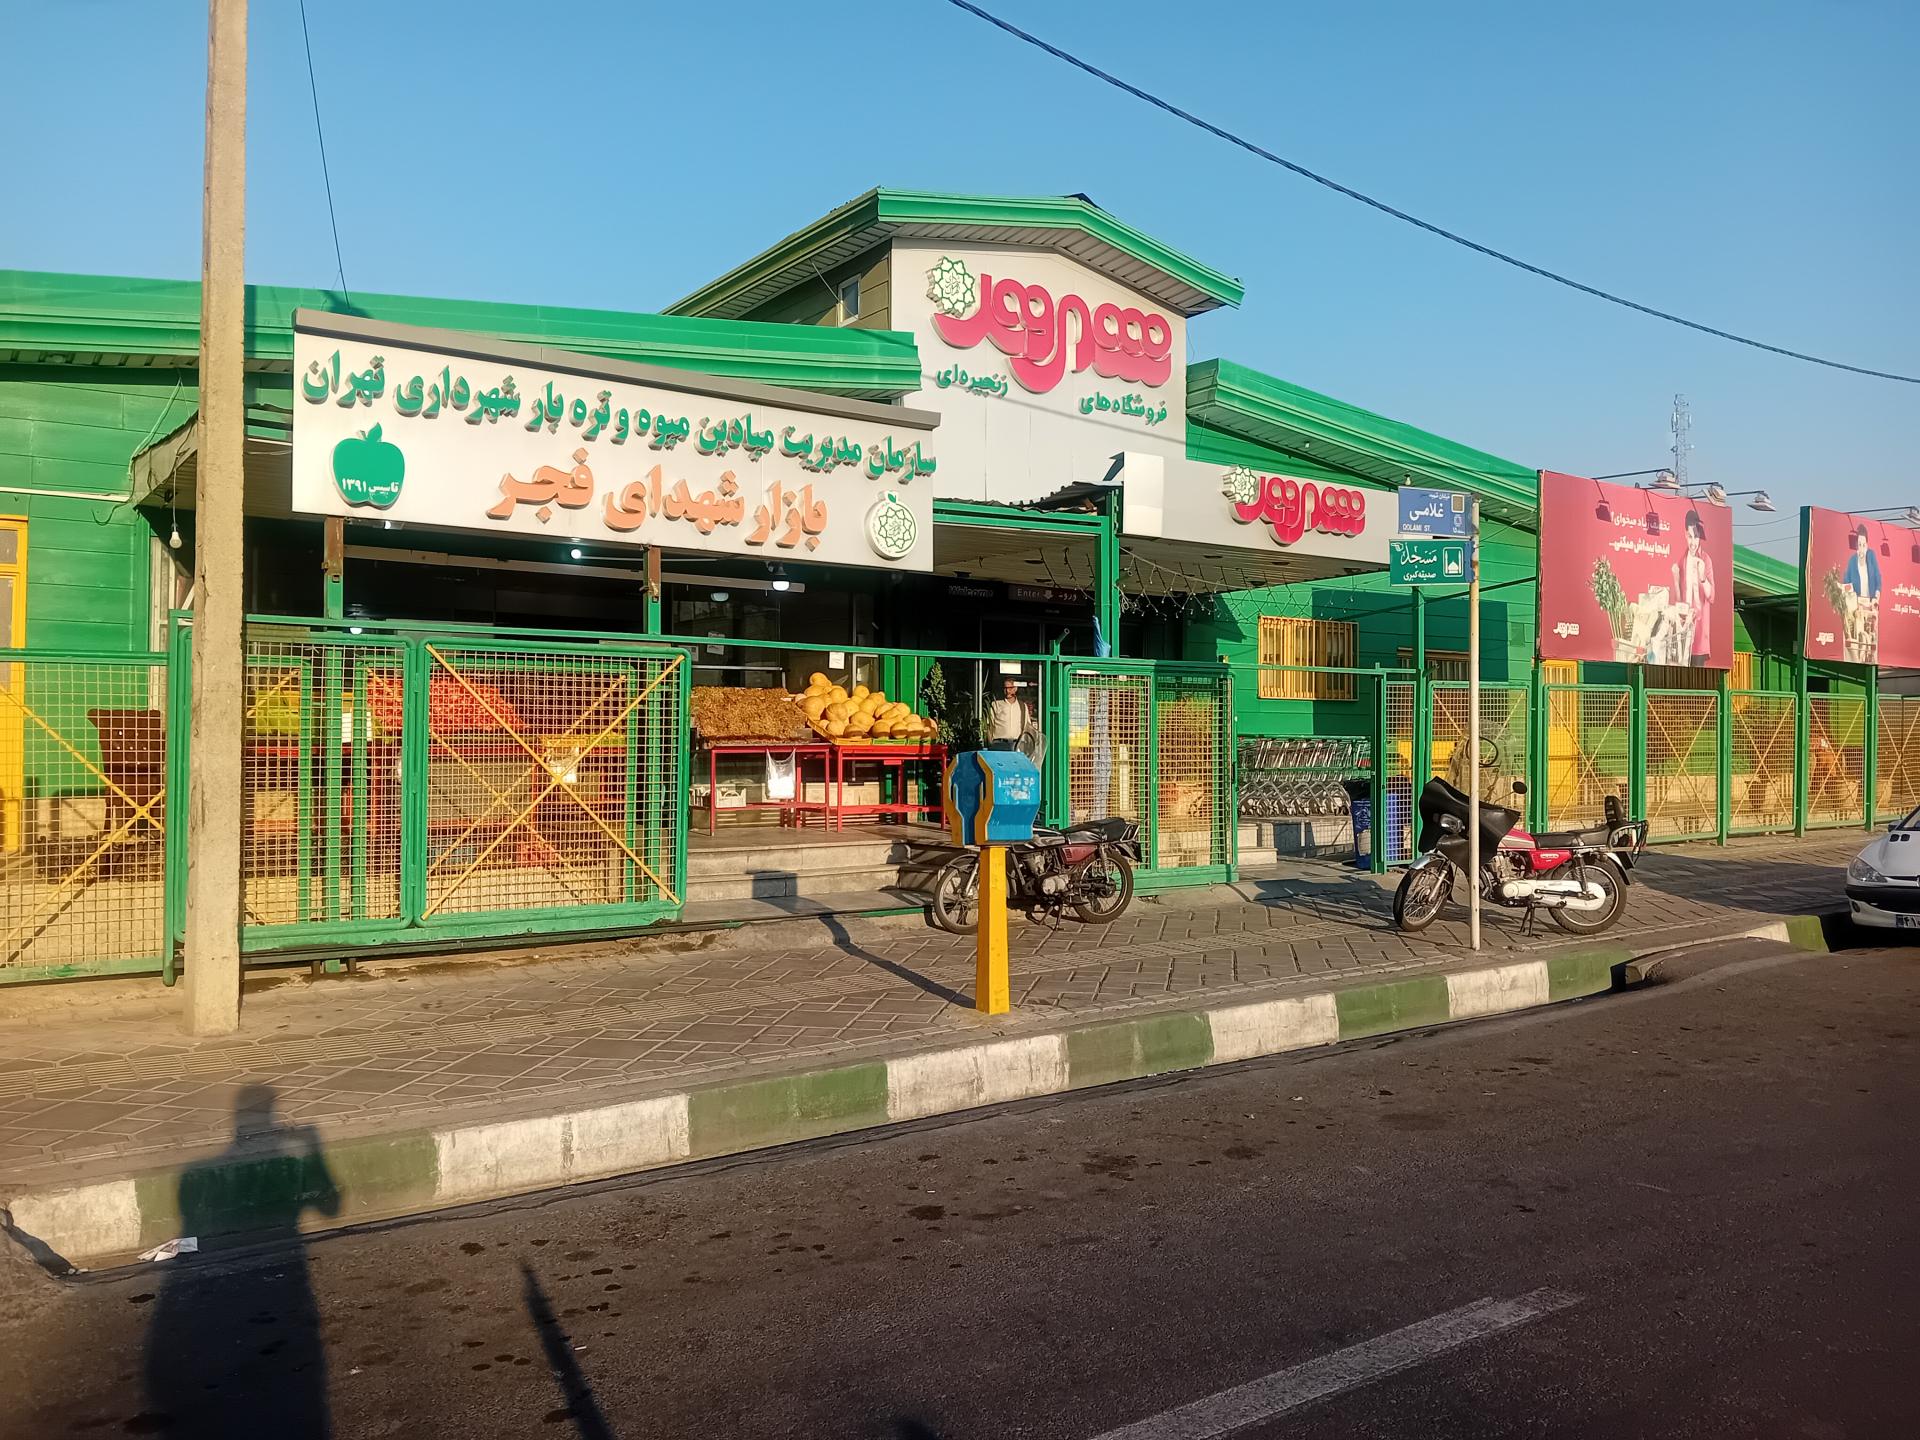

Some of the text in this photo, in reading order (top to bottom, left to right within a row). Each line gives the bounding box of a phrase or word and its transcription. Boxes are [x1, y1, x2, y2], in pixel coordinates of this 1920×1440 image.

[299, 349, 386, 408] تهران
[392, 364, 522, 425] شهرداری
[568, 389, 613, 442] تره
[610, 407, 630, 445] و
[633, 407, 690, 451] میوه
[693, 412, 775, 463] میادین
[779, 424, 862, 475] مدیریت
[864, 435, 937, 485] سازمان
[342, 477, 367, 493] ۱۳۹۱
[485, 447, 594, 524] فجر
[602, 463, 745, 536] شهدای
[744, 479, 828, 552] بازار
[1409, 502, 1444, 521] غلامی
[1016, 588, 1041, 599] Enter
